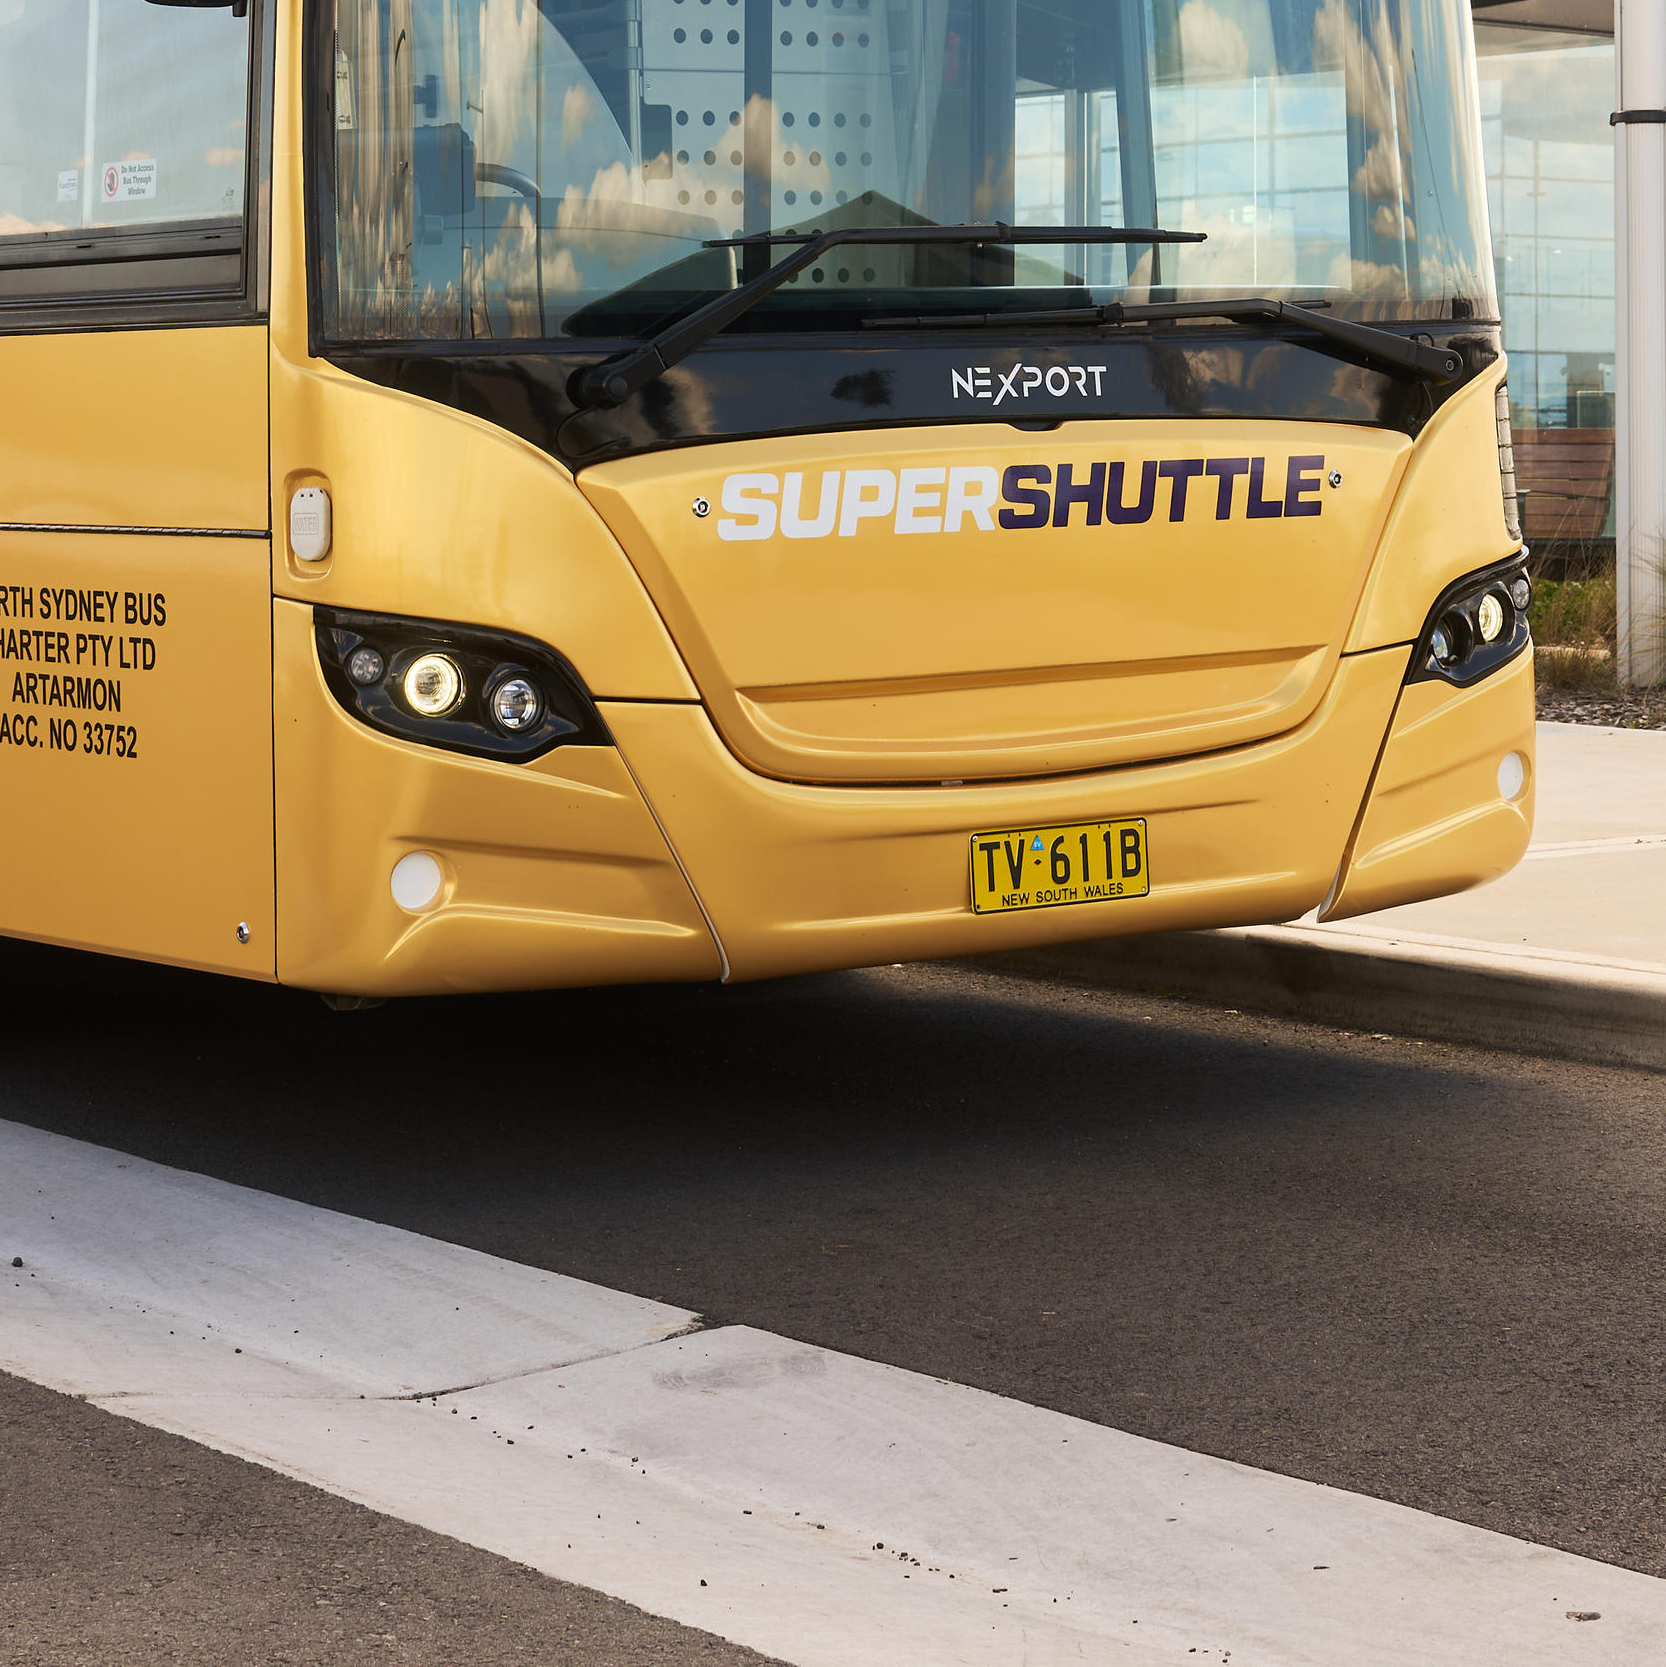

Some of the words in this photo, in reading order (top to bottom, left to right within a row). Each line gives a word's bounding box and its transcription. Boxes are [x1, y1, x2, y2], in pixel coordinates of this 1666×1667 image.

[121, 166, 128, 174] Do
[137, 164, 154, 172] Access
[132, 175, 151, 185] Through
[951, 363, 1108, 406] NEXPORT
[717, 455, 1325, 541] SUPERSHUTTLE
[39, 587, 119, 623] SYDNEY
[124, 592, 167, 627] BUS
[76, 633, 114, 667] PTY
[119, 636, 156, 670] LTD
[12, 671, 121, 713] ARTARMON
[0, 712, 44, 748] ACC.
[49, 717, 78, 752] NO
[83, 721, 138, 759] 33752
[1002, 892, 1031, 907] NEW
[1036, 887, 1078, 903] SOUTH
[1083, 882, 1124, 897] WALES
